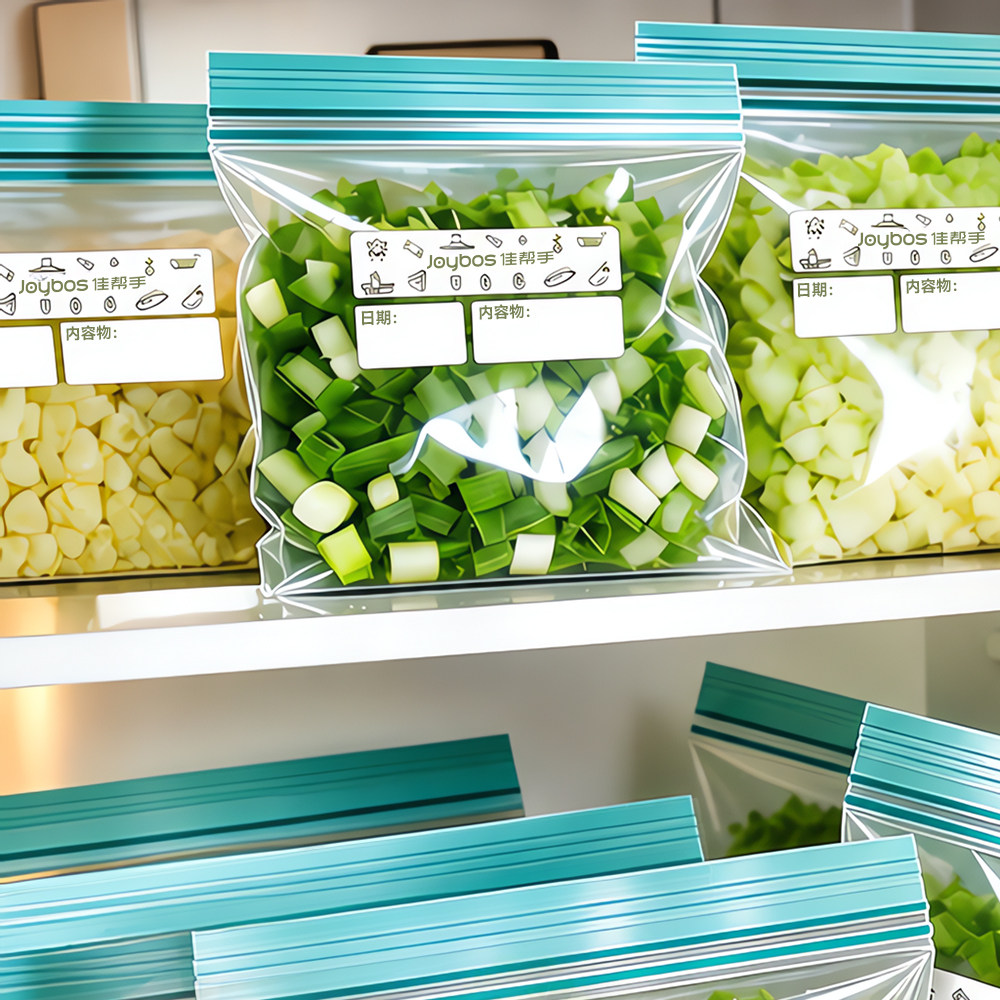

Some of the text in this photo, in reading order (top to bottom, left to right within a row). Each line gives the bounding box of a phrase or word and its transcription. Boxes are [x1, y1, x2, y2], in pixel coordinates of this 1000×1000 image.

[858, 231, 985, 249] Joybos 佳帮手
[427, 251, 554, 271] Joybos 佳帮手
[19, 276, 146, 296] Joybos 佳帮手
